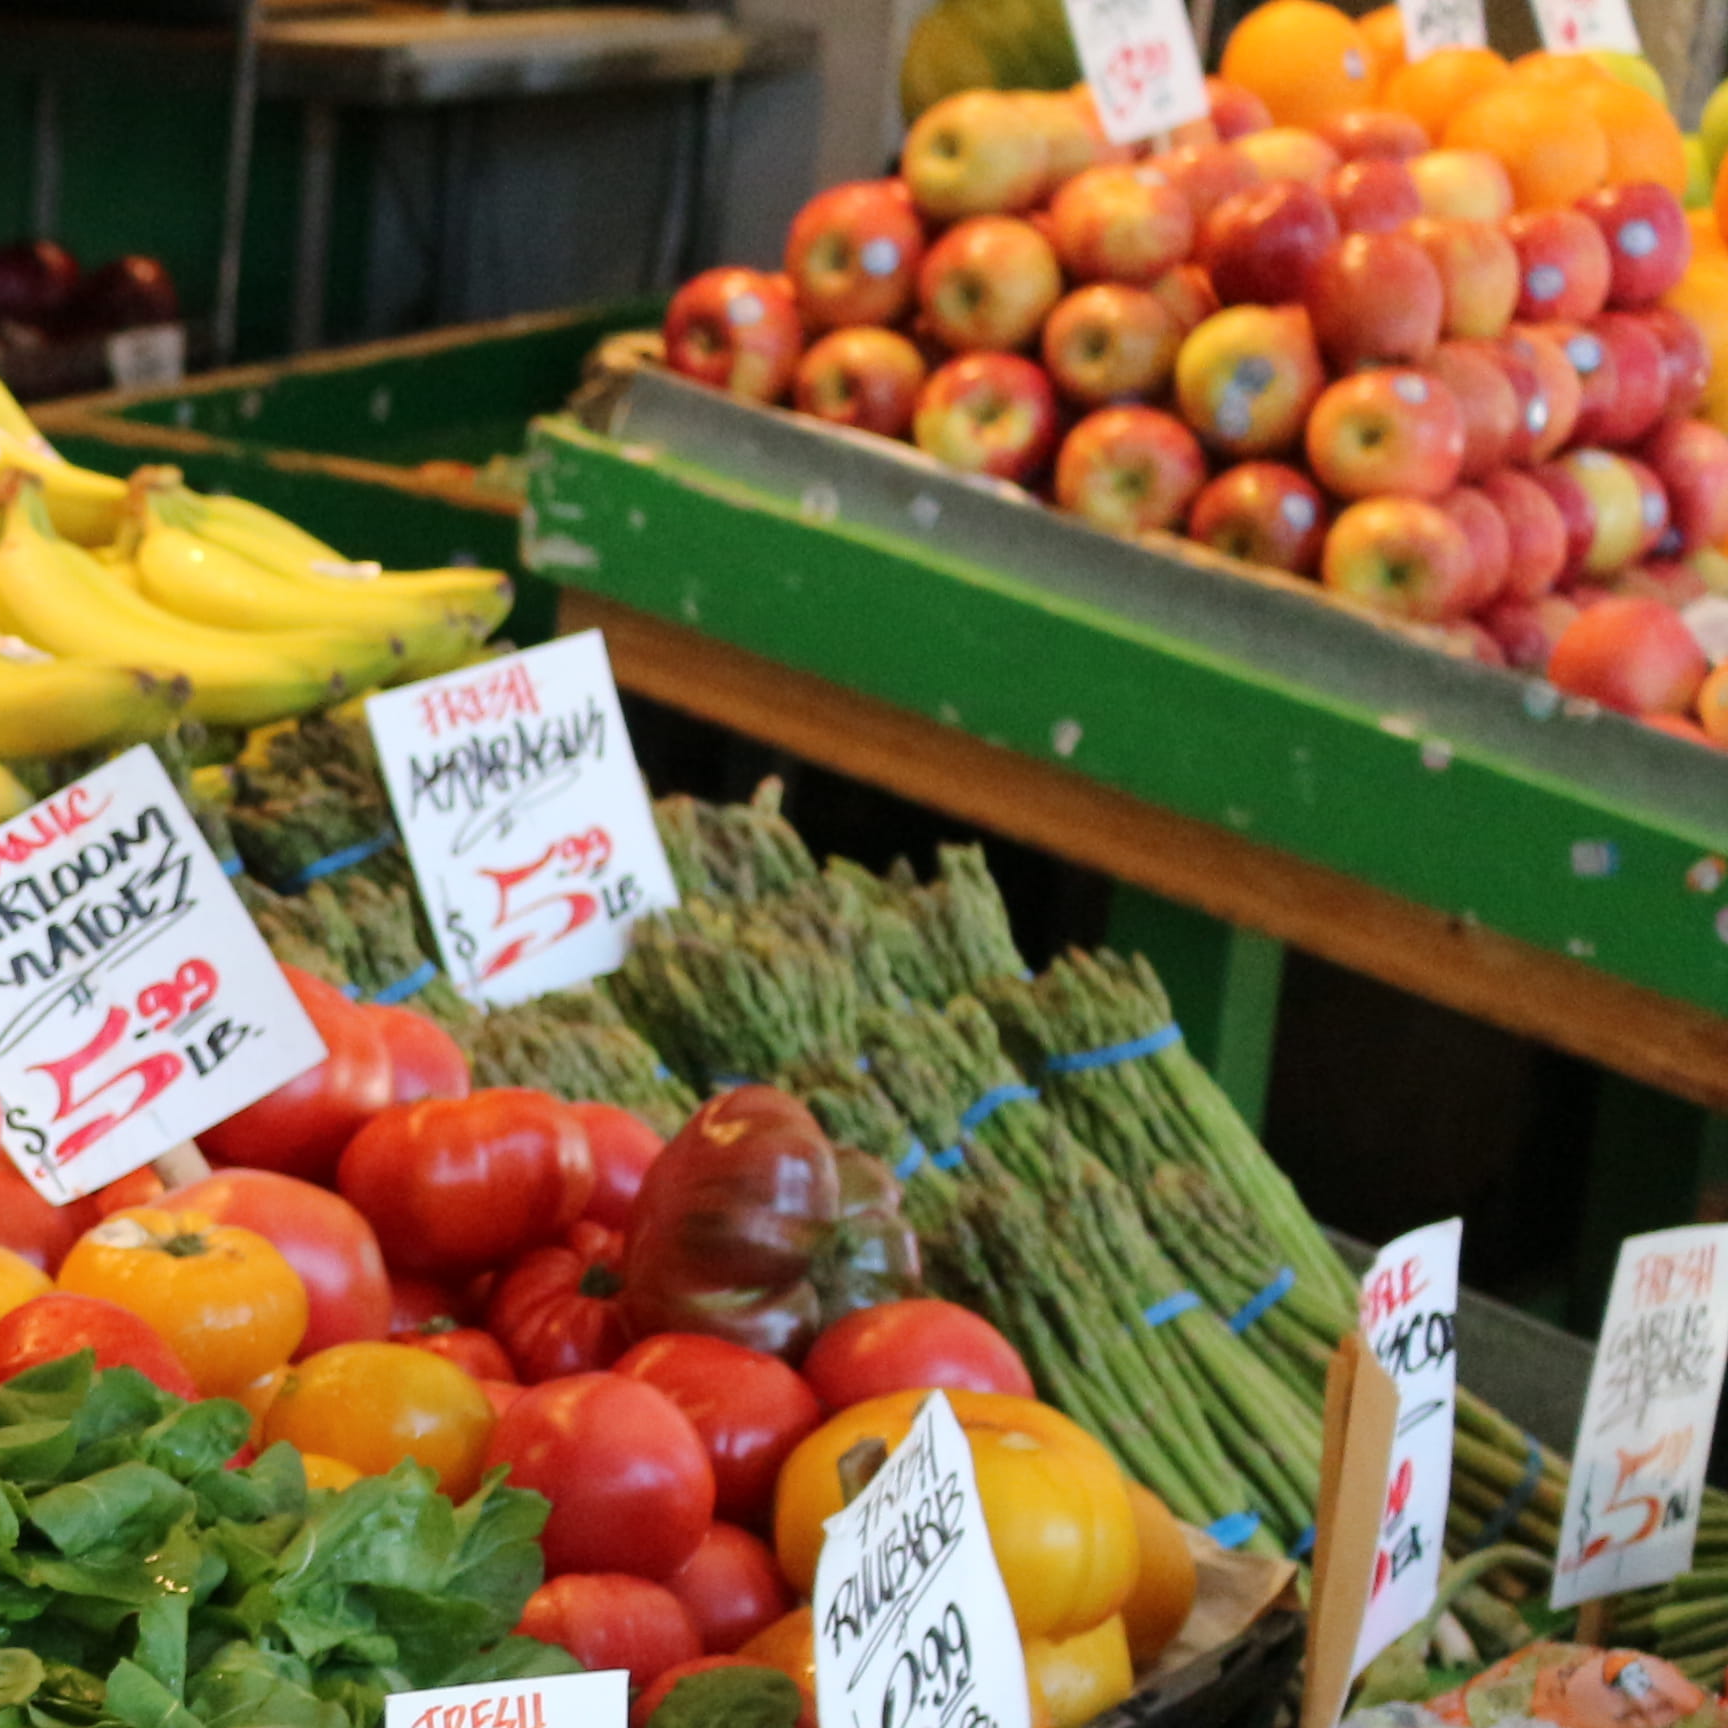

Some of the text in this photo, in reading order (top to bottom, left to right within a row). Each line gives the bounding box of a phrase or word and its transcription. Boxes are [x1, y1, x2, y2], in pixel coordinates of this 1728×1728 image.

[417, 660, 543, 737] FRESH
[856, 1410, 939, 1549] FRESH
[822, 1470, 966, 1659] RHUBARB
